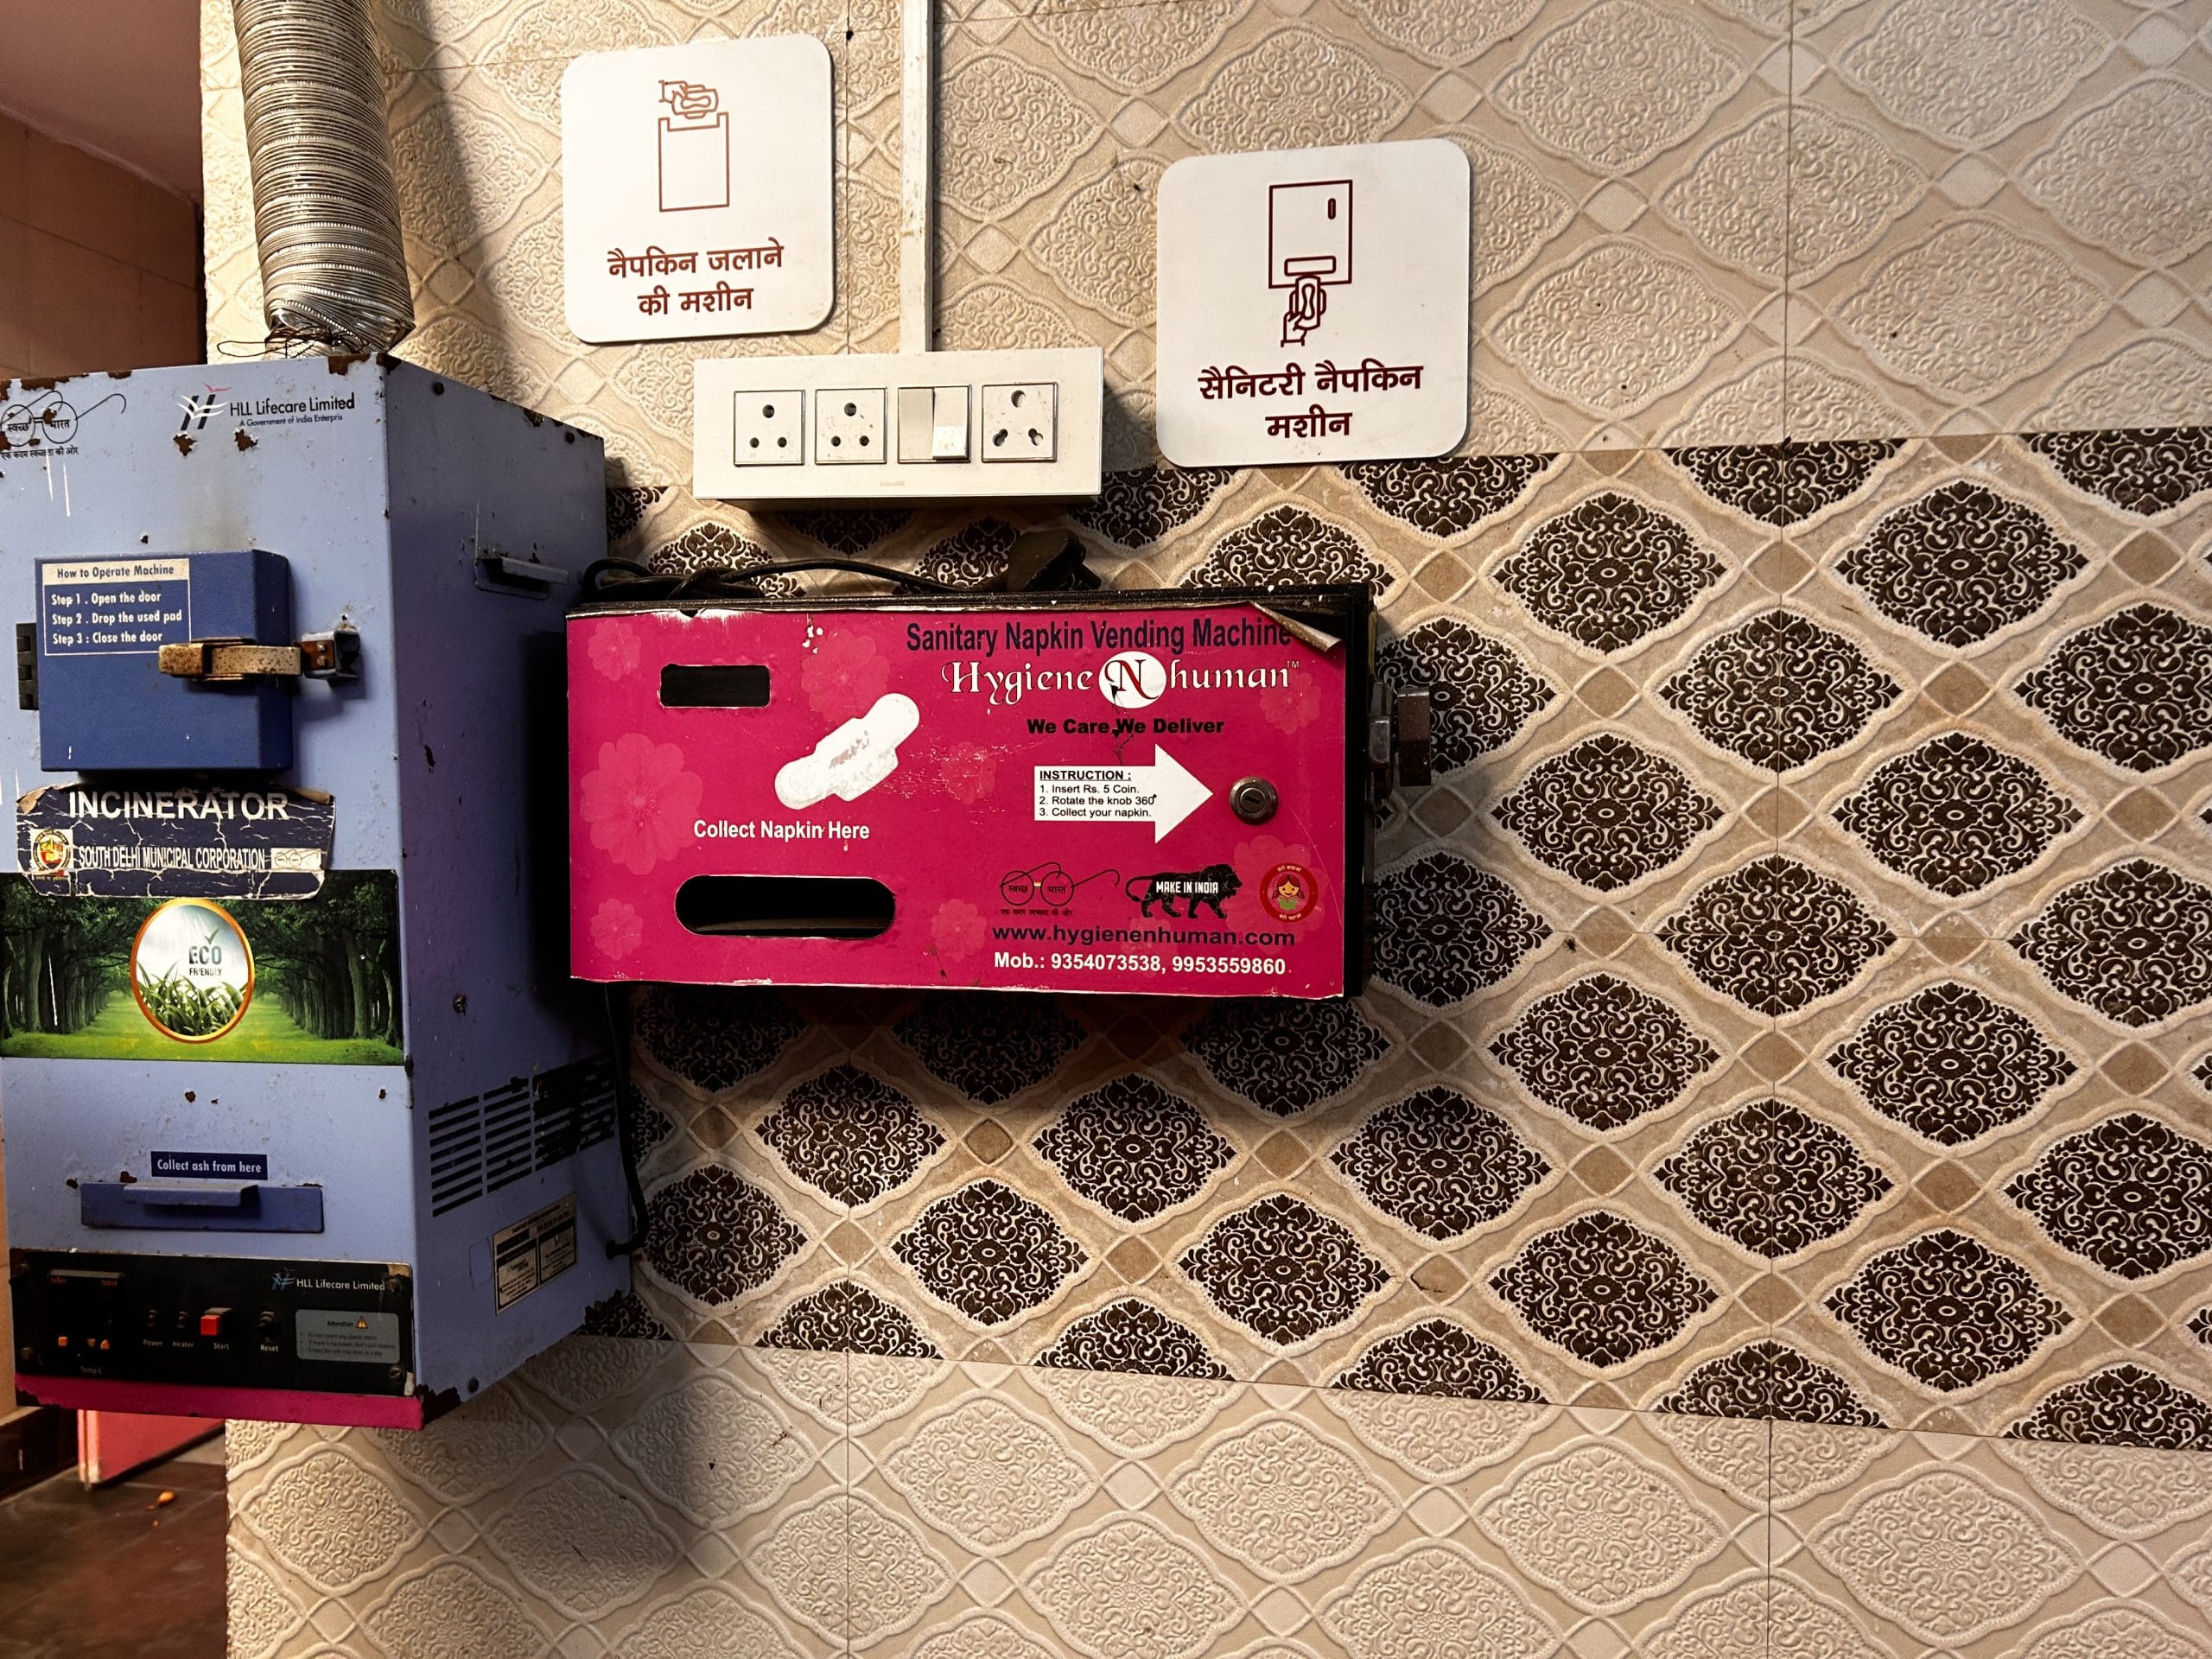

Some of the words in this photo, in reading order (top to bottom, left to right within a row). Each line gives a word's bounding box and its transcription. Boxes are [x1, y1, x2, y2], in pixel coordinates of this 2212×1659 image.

[607, 245, 698, 277] नैपकिन
[707, 237, 784, 270] जलाने
[638, 285, 670, 315] की
[678, 281, 753, 312] मशीन
[1198, 363, 1306, 399] सैनिटरी
[1315, 359, 1423, 393] नैपकिन
[230, 402, 251, 416] HLL
[256, 398, 307, 415] Lifecare
[309, 392, 355, 411] Limited
[246, 417, 286, 427] Government
[1265, 404, 1352, 438] मशीन
[57, 568, 77, 578] How
[79, 569, 89, 577] to
[92, 566, 130, 579] Operate
[134, 564, 175, 575] Machine
[51, 594, 73, 607] Step
[76, 594, 80, 604] 1
[91, 593, 117, 606] Open
[119, 591, 135, 603] the
[138, 590, 162, 602] door
[52, 613, 73, 626] Step
[76, 613, 82, 624] 2
[92, 613, 115, 626] Drop
[118, 611, 134, 623] the
[137, 610, 160, 622] used
[163, 609, 182, 624] pad
[53, 633, 73, 646] Step
[77, 632, 83, 644] 3
[92, 631, 118, 643] Close
[121, 631, 137, 642] the
[139, 630, 162, 642] door
[906, 622, 998, 658] Sanitary
[1006, 620, 1083, 657] Napkin
[1090, 620, 1184, 655] Vending
[1192, 617, 1293, 647] Machine
[941, 660, 1094, 706] Hygiene
[1104, 658, 1160, 701] N
[1170, 658, 1292, 689] human
[1027, 718, 1057, 734] We
[1116, 717, 1146, 734] We
[1154, 717, 1224, 734] Deliver
[1039, 770, 1123, 780] INSTRUCTION
[1039, 785, 1048, 793] 1.
[1052, 785, 1080, 793] Insert
[1084, 785, 1100, 793] Rs.
[1113, 785, 1140, 793] Coin.
[69, 791, 289, 820] INCINERATOR
[1039, 797, 1048, 805] 2.
[1052, 797, 1085, 805] Rotate
[1089, 797, 1103, 805] the
[1107, 797, 1132, 805] knob
[1039, 808, 1048, 817] 3.
[1052, 808, 1086, 817] Collect
[1089, 810, 1111, 818] your
[1115, 808, 1152, 818] napkin.
[693, 820, 755, 838] Collect
[760, 820, 822, 842] Napkin
[828, 821, 870, 839] Here
[79, 846, 112, 868] SOUTH
[114, 846, 140, 868] DELHI
[143, 846, 194, 868] MUNICIPAL
[195, 848, 265, 869] CORPORATION
[1156, 881, 1181, 893] MAKE
[1184, 881, 1193, 893] IN
[1195, 881, 1218, 893] INDIA
[992, 925, 1295, 946] www.hygienenhuman.com
[189, 945, 222, 965] ECO
[994, 951, 1045, 969] Mob.:
[1051, 954, 1166, 975] 9354073538,
[1172, 956, 1286, 975] 9953559860
[189, 967, 222, 976] FRIENDLY
[157, 1159, 189, 1171] Collect
[192, 1160, 209, 1171] ash
[213, 1160, 236, 1172] from
[239, 1160, 261, 1173] here
[296, 1279, 313, 1288] HLL
[315, 1279, 350, 1290] Lifecare
[353, 1281, 385, 1291] Limited
